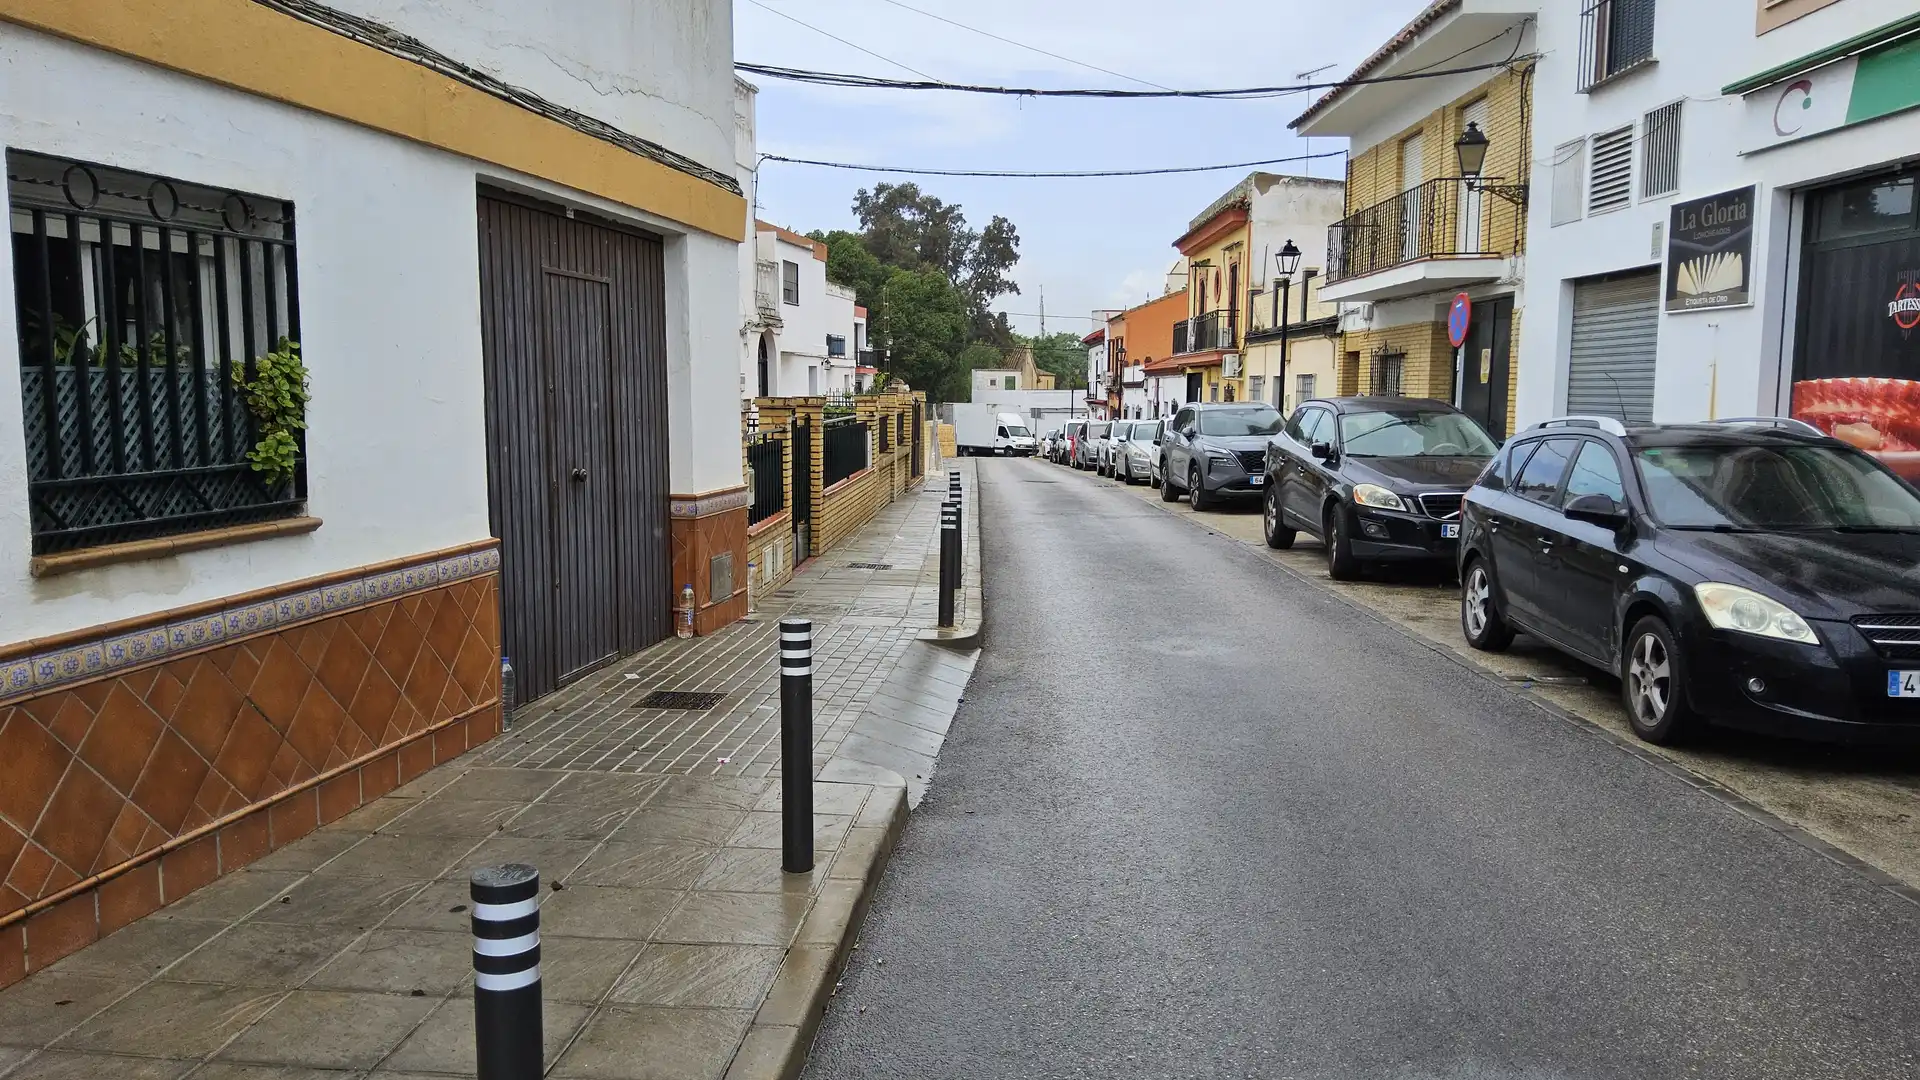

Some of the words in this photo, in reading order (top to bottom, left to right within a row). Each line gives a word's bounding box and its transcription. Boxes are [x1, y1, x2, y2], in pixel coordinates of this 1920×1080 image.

[1679, 208, 1696, 231] La
[1701, 197, 1747, 227] Gloria
[1685, 297, 1708, 306] ETIQUETA
[1708, 296, 1716, 304] DE
[1716, 295, 1728, 303] ORO
